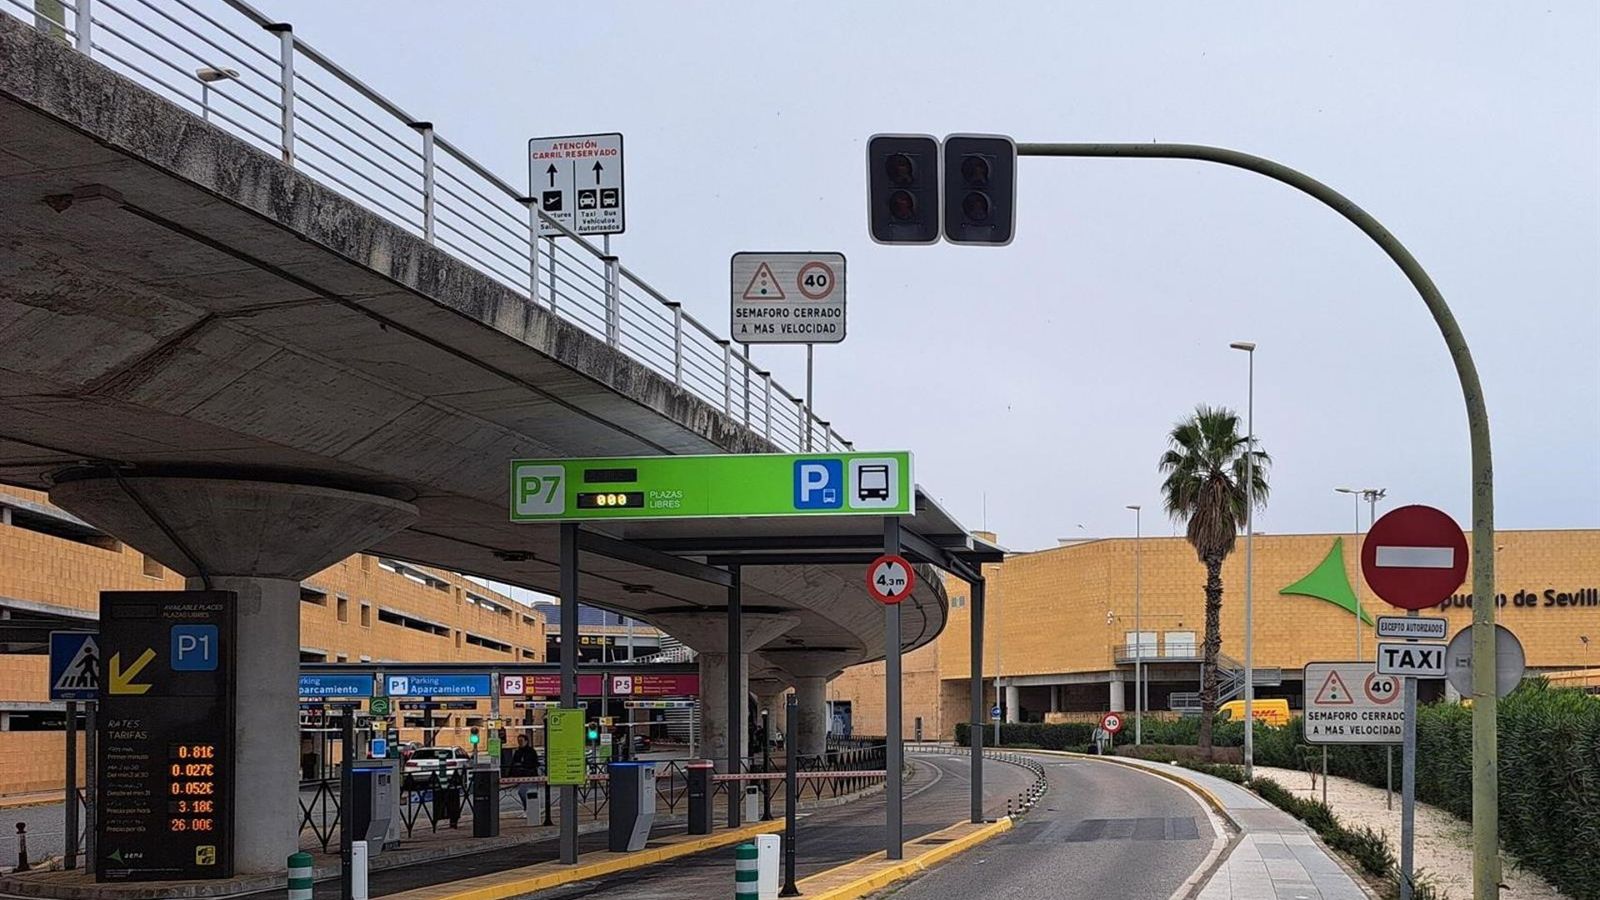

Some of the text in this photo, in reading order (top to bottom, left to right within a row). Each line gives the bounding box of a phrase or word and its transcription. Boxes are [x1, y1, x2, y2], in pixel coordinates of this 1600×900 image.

[553, 140, 597, 150] ATENCIÓN
[532, 149, 617, 160] CARRIL RESERVADO
[804, 275, 827, 287] 40
[736, 308, 842, 318] SEMAFORO CERRADO
[741, 324, 837, 333] A MAS VELOCIDAD
[520, 476, 561, 504] P7
[650, 490, 683, 499] PLAZAS
[650, 500, 681, 508] LIBRES
[1513, 589, 1538, 608] de
[1543, 588, 1600, 608] Sevill
[1381, 621, 1444, 633] EXCEPTO AUTORIZADOS
[178, 634, 210, 660] P1
[1384, 649, 1442, 670] TAXI
[299, 676, 321, 686] rking
[391, 680, 407, 692] P1
[410, 676, 440, 686] Parking
[506, 680, 522, 690] P5
[615, 679, 630, 690] P5
[299, 685, 359, 695] parcamiento
[410, 685, 476, 695] Aparcamiento
[1371, 681, 1392, 693] 40
[1308, 711, 1358, 721] SEMAFORO
[108, 720, 140, 728] RATES
[108, 731, 148, 739] TARIFAS
[1313, 726, 1402, 735] A MAS VELOCIDAD
[179, 746, 215, 758] 0.81€
[172, 764, 215, 776] 0.027€
[172, 782, 214, 794] 0.052€
[178, 801, 214, 813] 3.18€
[171, 819, 214, 831] 26.00€
